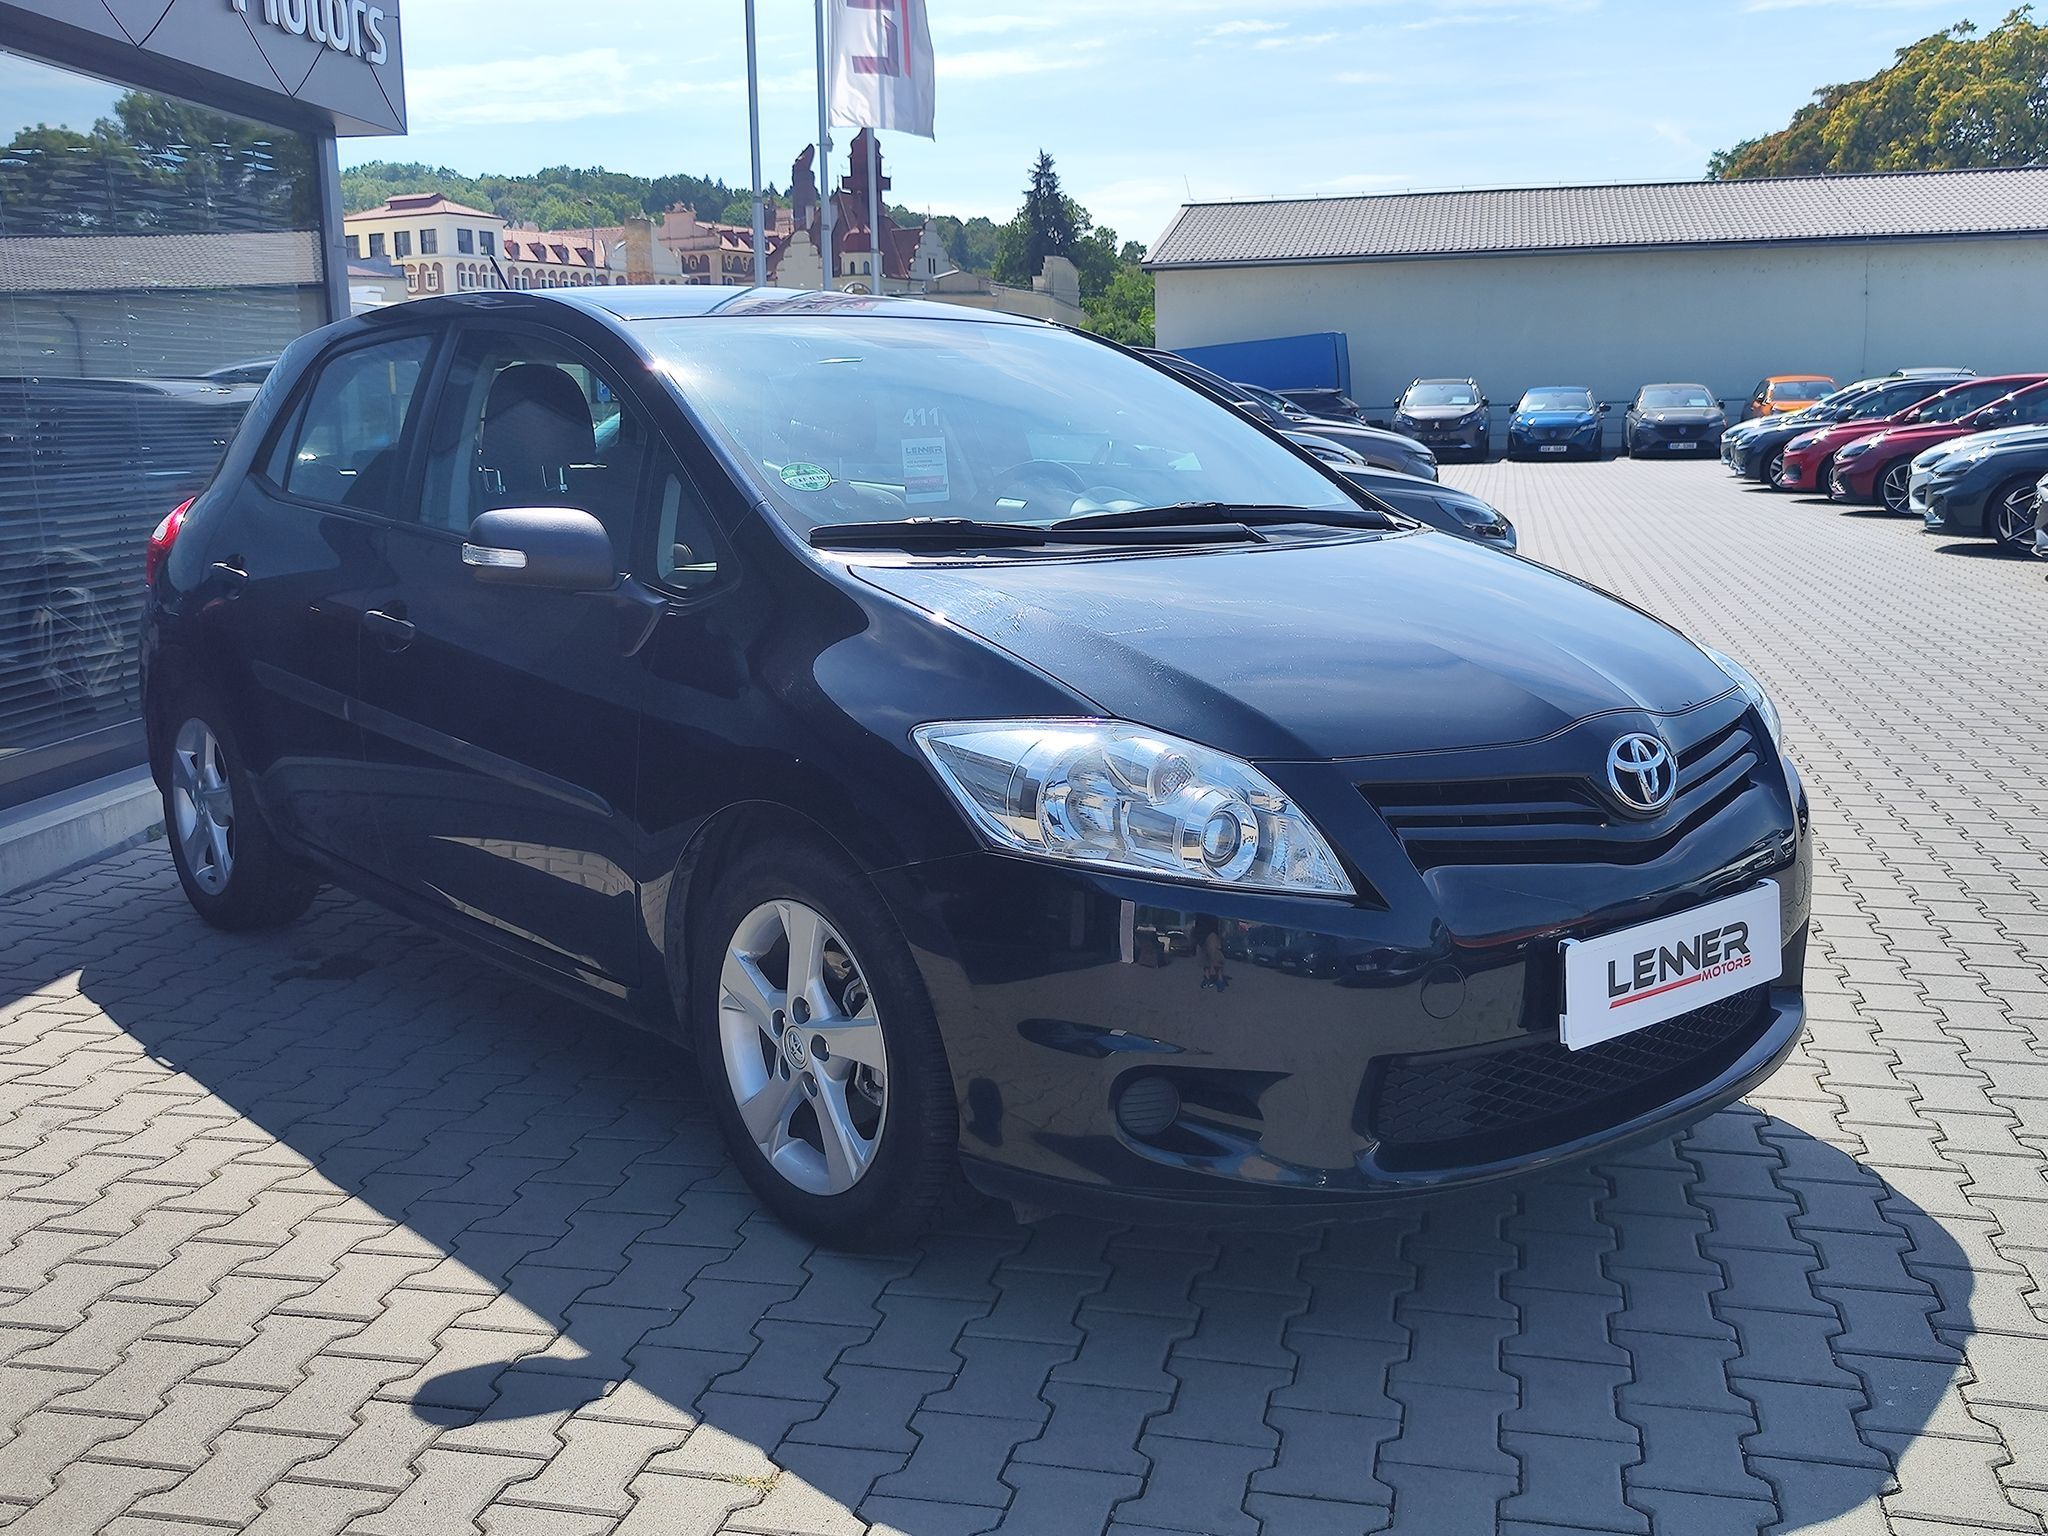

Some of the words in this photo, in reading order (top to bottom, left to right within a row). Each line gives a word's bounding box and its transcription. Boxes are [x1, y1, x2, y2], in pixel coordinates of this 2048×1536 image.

[231, 0, 388, 66] otors
[903, 407, 940, 427] 411
[1607, 921, 1751, 998] LENNER
[1701, 954, 1752, 982] MOTORS
